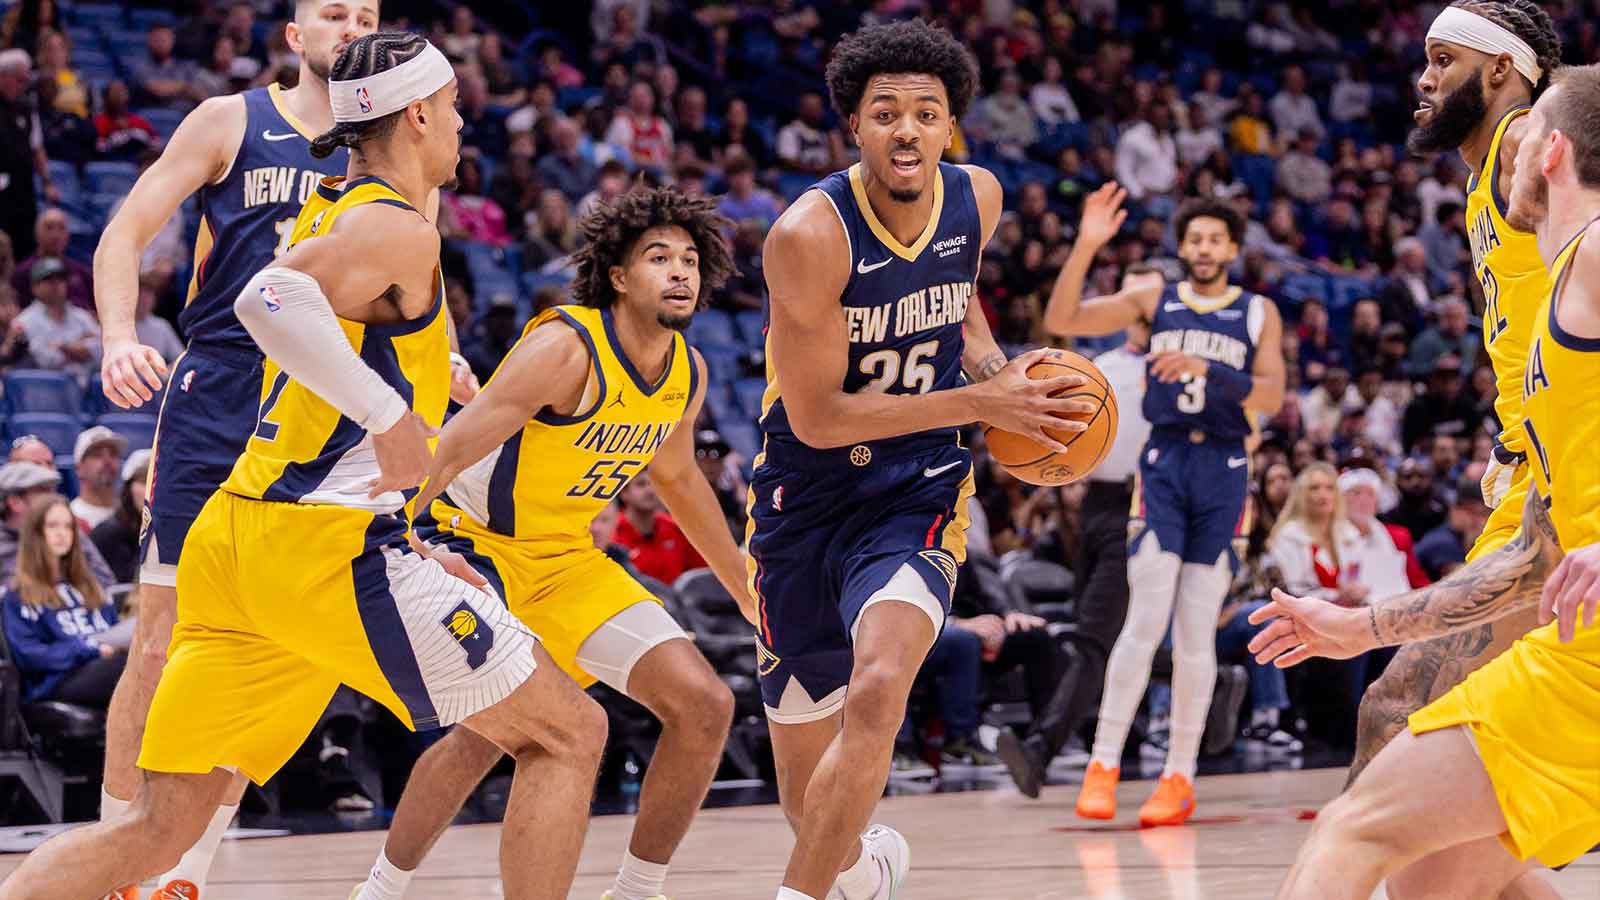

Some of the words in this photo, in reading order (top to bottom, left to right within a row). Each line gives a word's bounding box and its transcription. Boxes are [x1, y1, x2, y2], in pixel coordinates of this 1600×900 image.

[243, 166, 297, 209] NEW
[933, 235, 967, 253] NEWAGE
[939, 246, 961, 258] GARAGE
[843, 302, 892, 344] EW
[894, 281, 972, 338] ORLEANS
[1177, 372, 1207, 415] 3
[573, 420, 678, 455] INDIAN
[566, 460, 643, 500] 55
